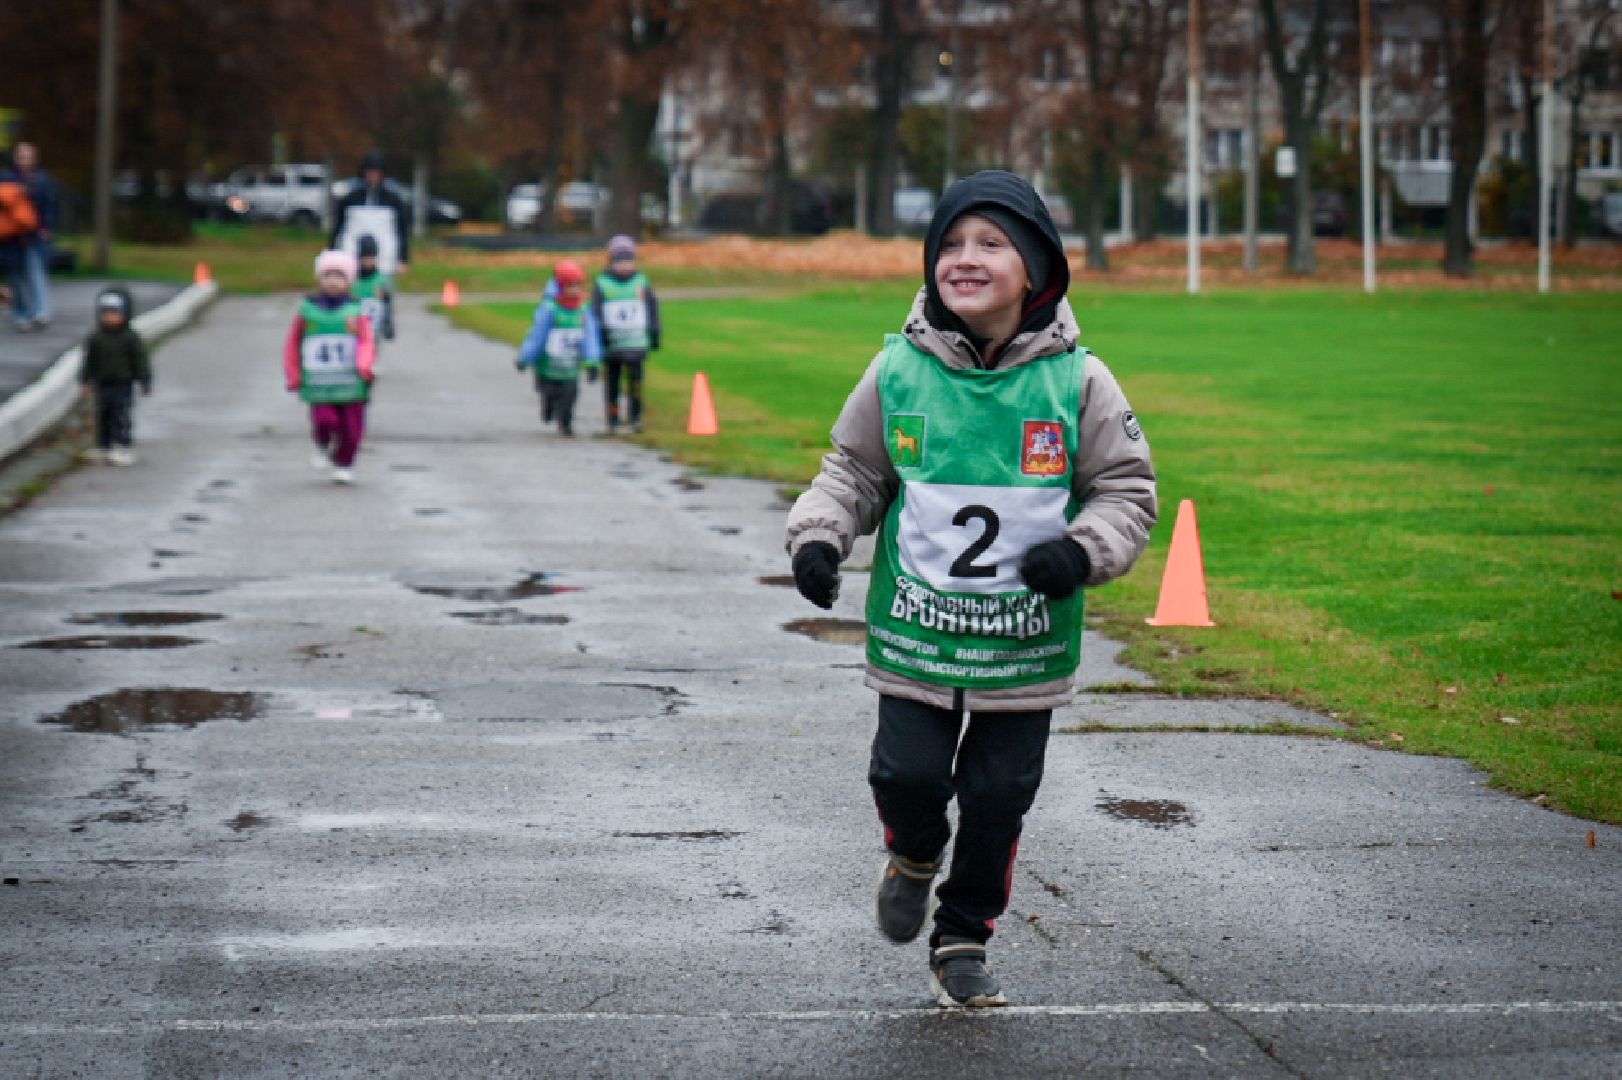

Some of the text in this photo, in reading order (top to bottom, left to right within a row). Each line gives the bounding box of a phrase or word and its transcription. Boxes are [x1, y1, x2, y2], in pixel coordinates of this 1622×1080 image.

[313, 343, 344, 362] 41
[949, 504, 1000, 577] 2
[1005, 592, 1046, 612] КЛУ
